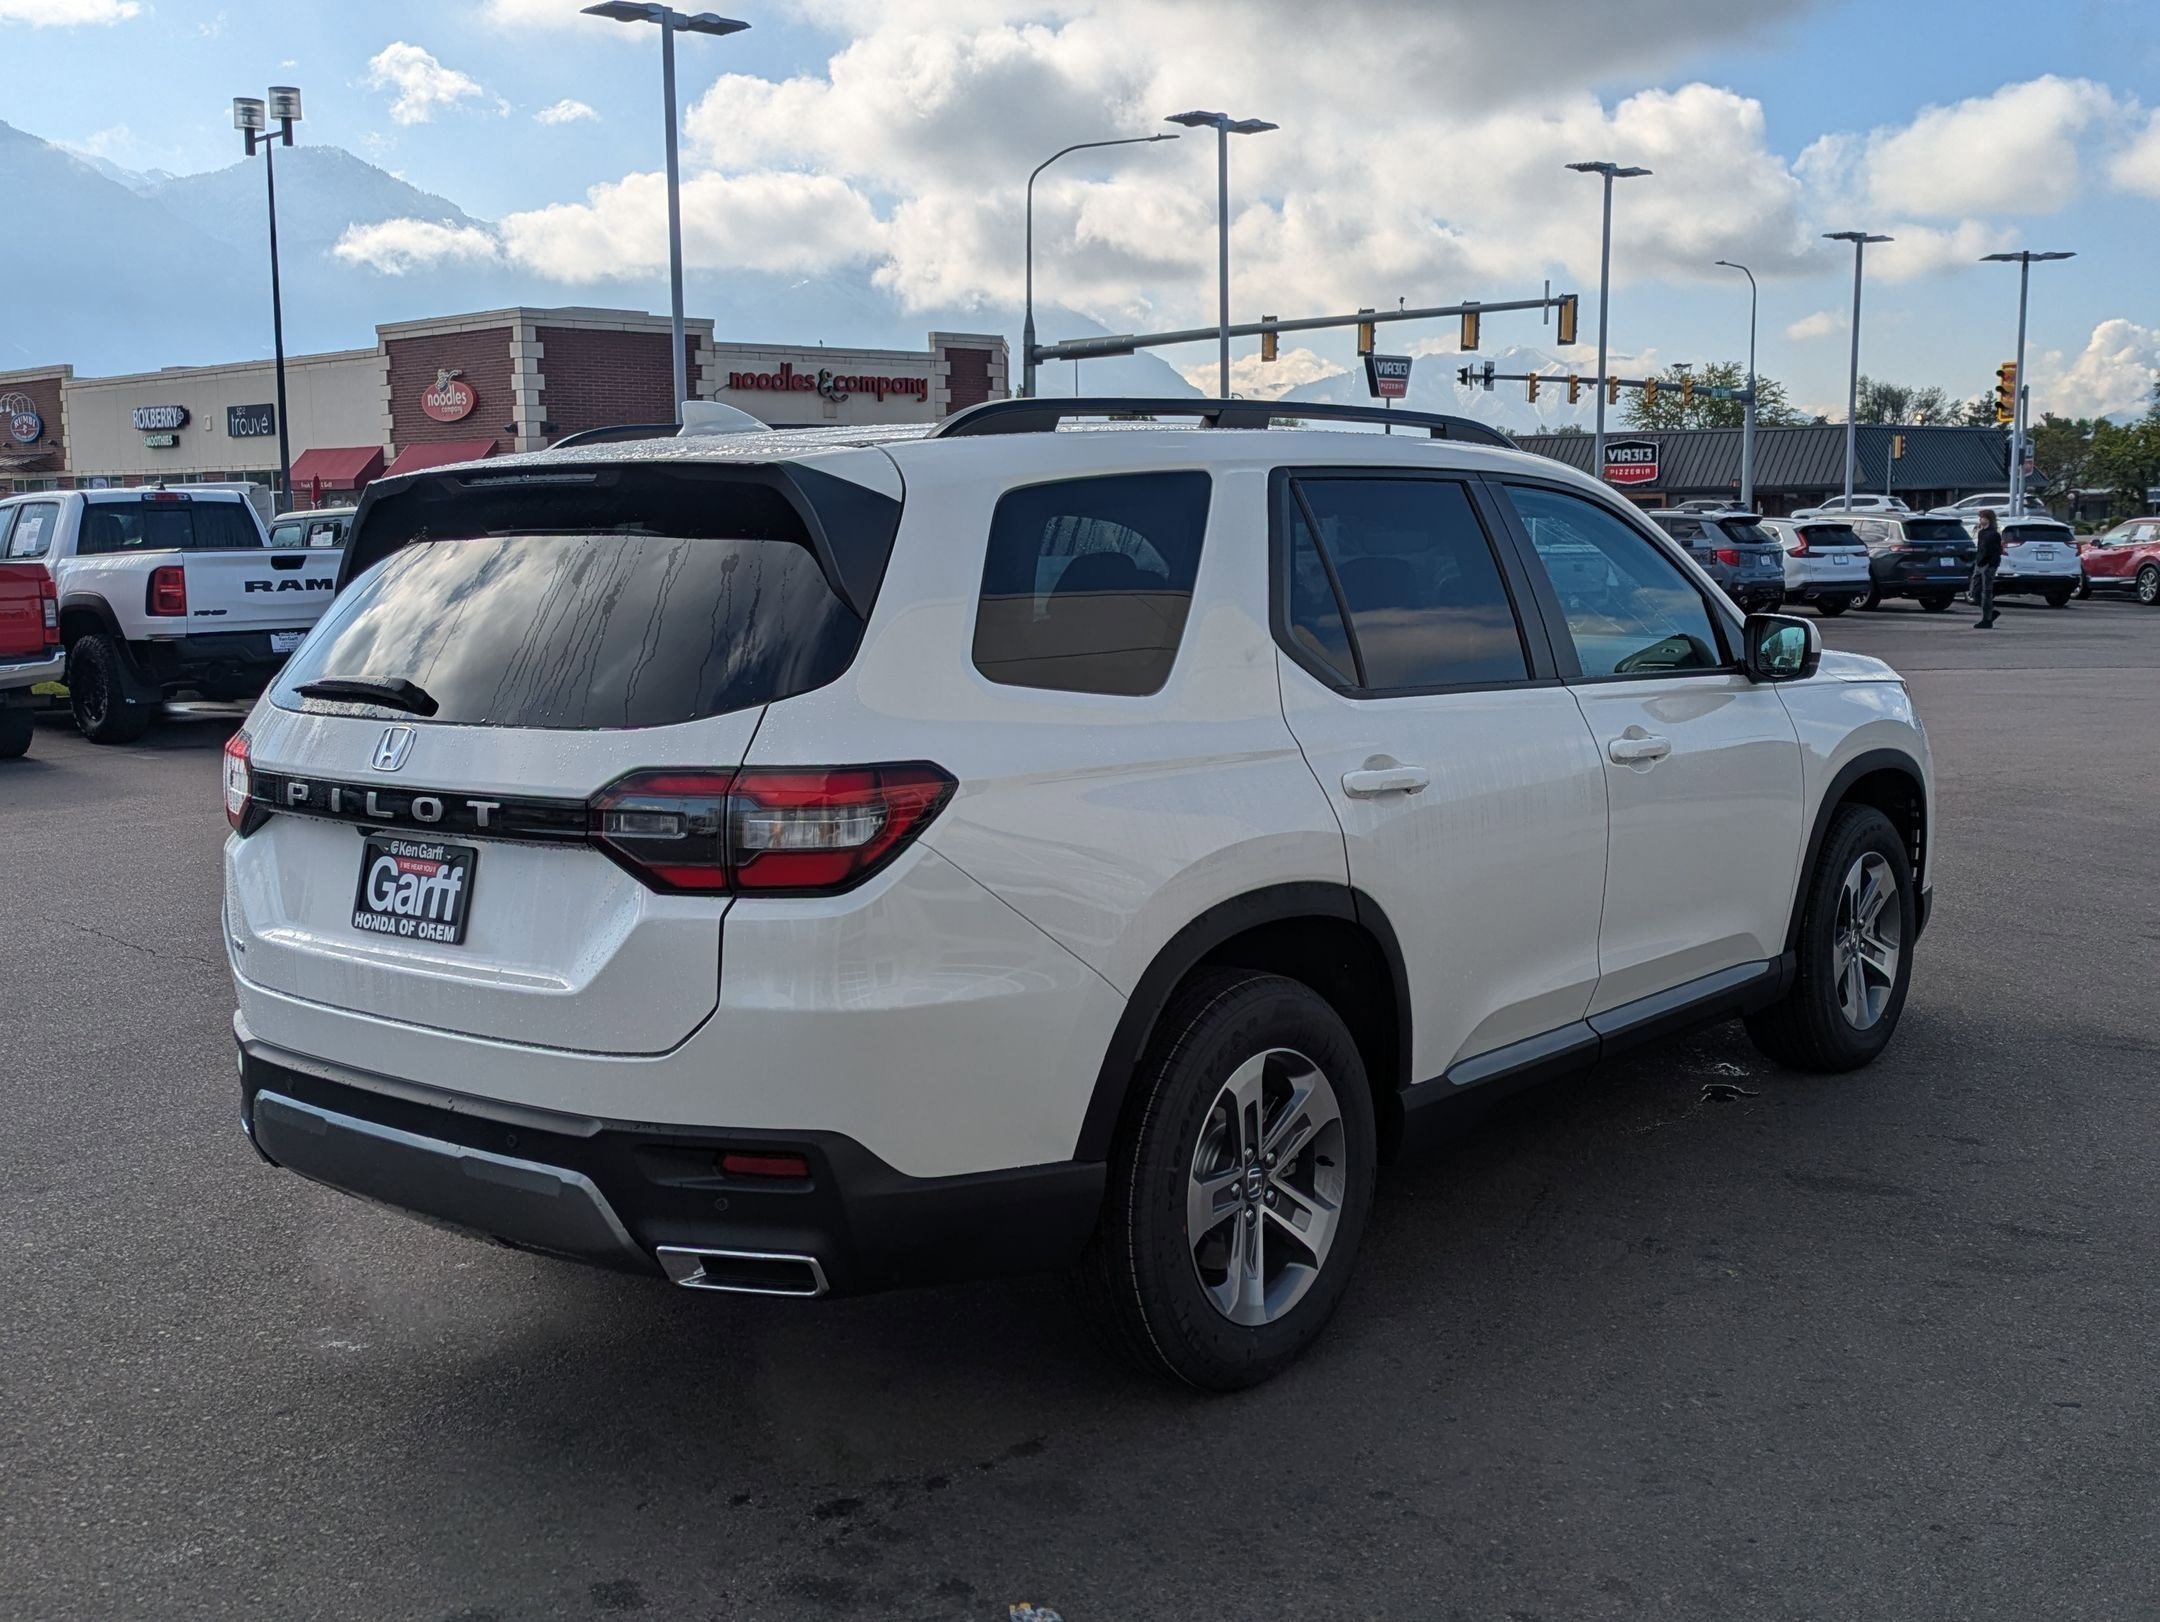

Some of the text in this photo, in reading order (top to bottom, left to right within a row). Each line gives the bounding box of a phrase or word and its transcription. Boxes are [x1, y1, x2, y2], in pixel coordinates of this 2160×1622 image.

[729, 362, 815, 391] noodles
[833, 374, 928, 401] company
[427, 384, 467, 407] noodles
[133, 407, 177, 429] ROXBERRY
[441, 405, 463, 414] company
[14, 415, 36, 428] RUMBI
[231, 413, 269, 436] trouvé
[143, 435, 173, 447] SMOOTHIES
[1607, 448, 1652, 462] VIA313
[245, 579, 333, 592] RAM
[287, 782, 500, 827] PILOT
[399, 841, 444, 860] Ken Garff
[424, 865, 433, 873] YOU
[367, 856, 464, 921] Garff
[354, 912, 455, 942] HONDA OF OREM
